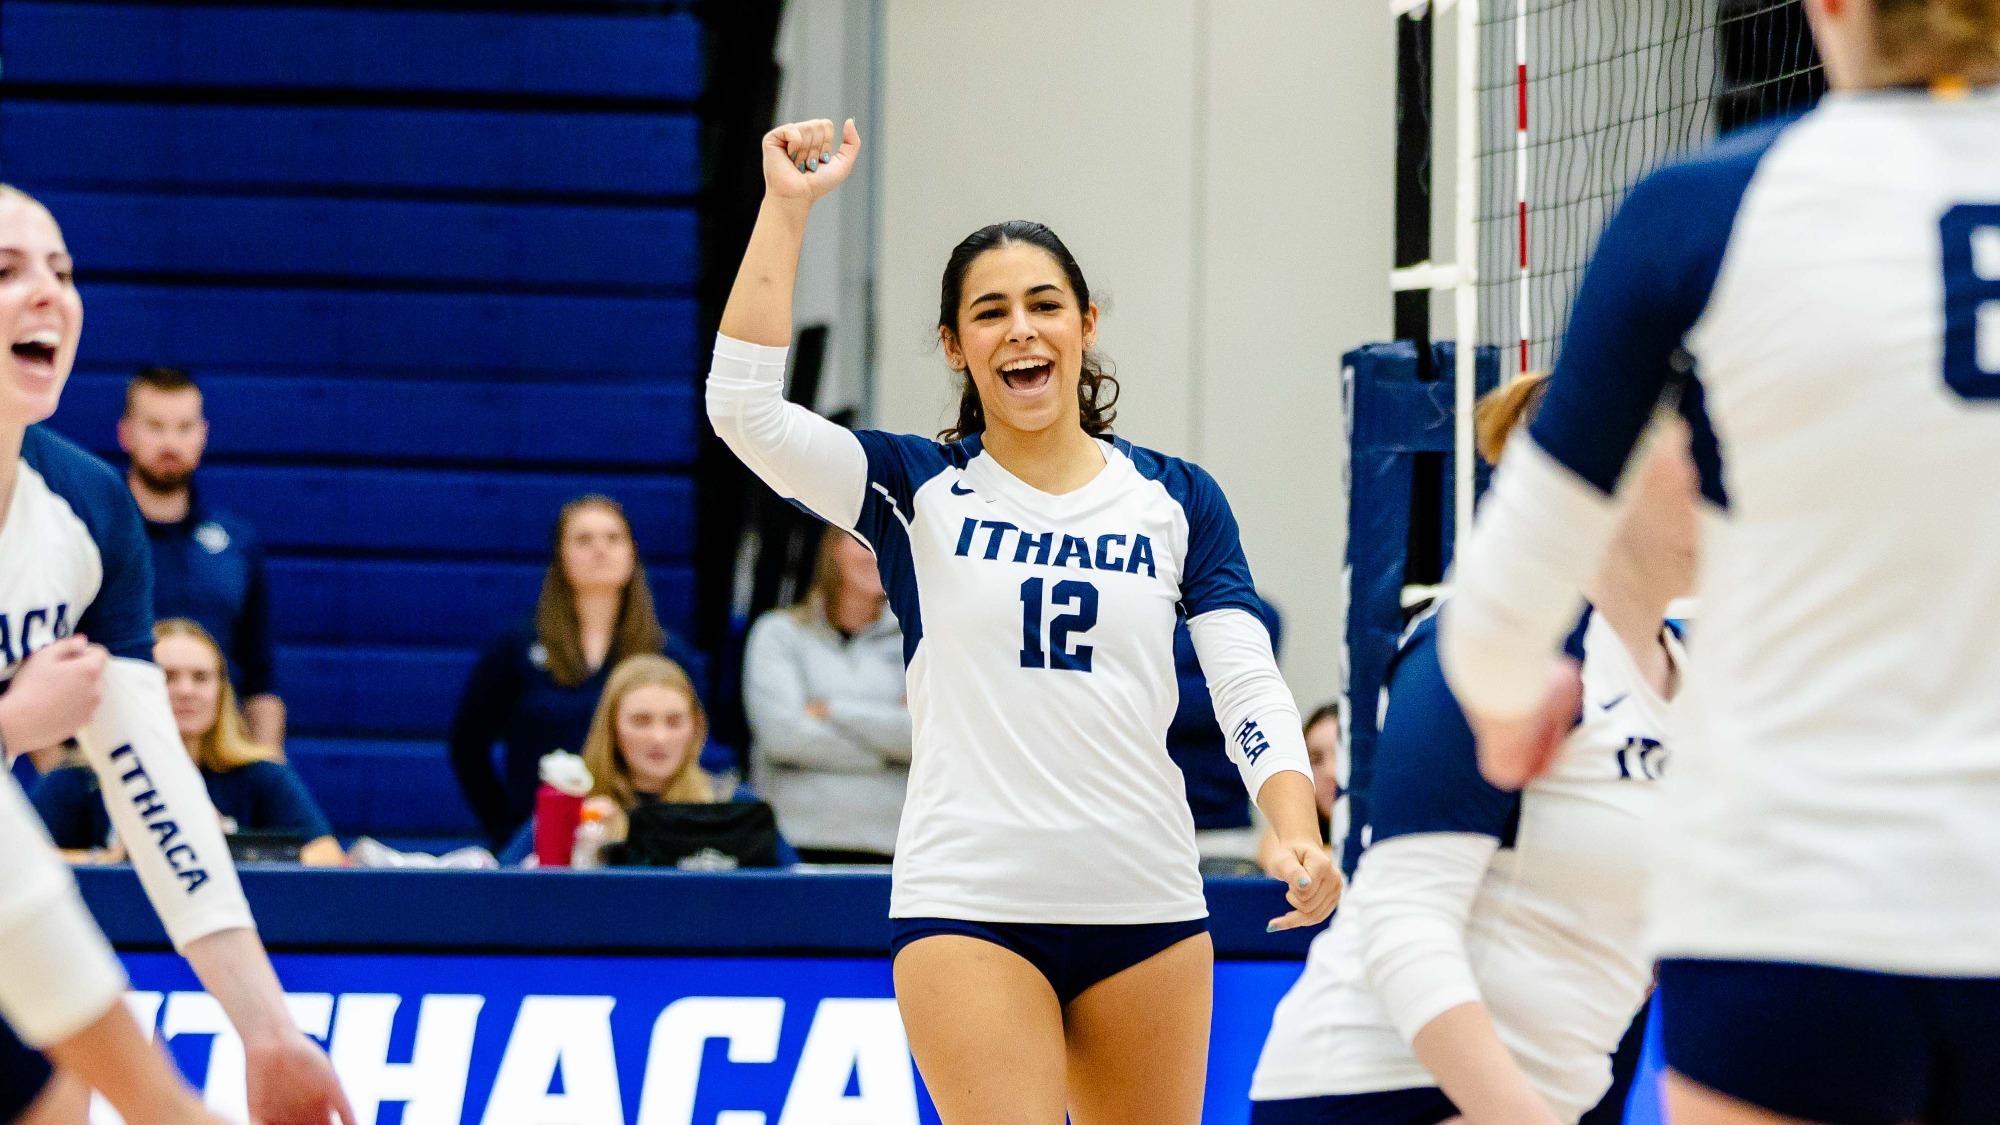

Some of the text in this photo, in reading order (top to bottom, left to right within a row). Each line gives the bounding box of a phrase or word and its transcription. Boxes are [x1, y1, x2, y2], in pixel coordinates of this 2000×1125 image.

[954, 516, 1158, 580] ITHACA
[1019, 576, 1099, 674] 12
[110, 743, 210, 894] ITHACA
